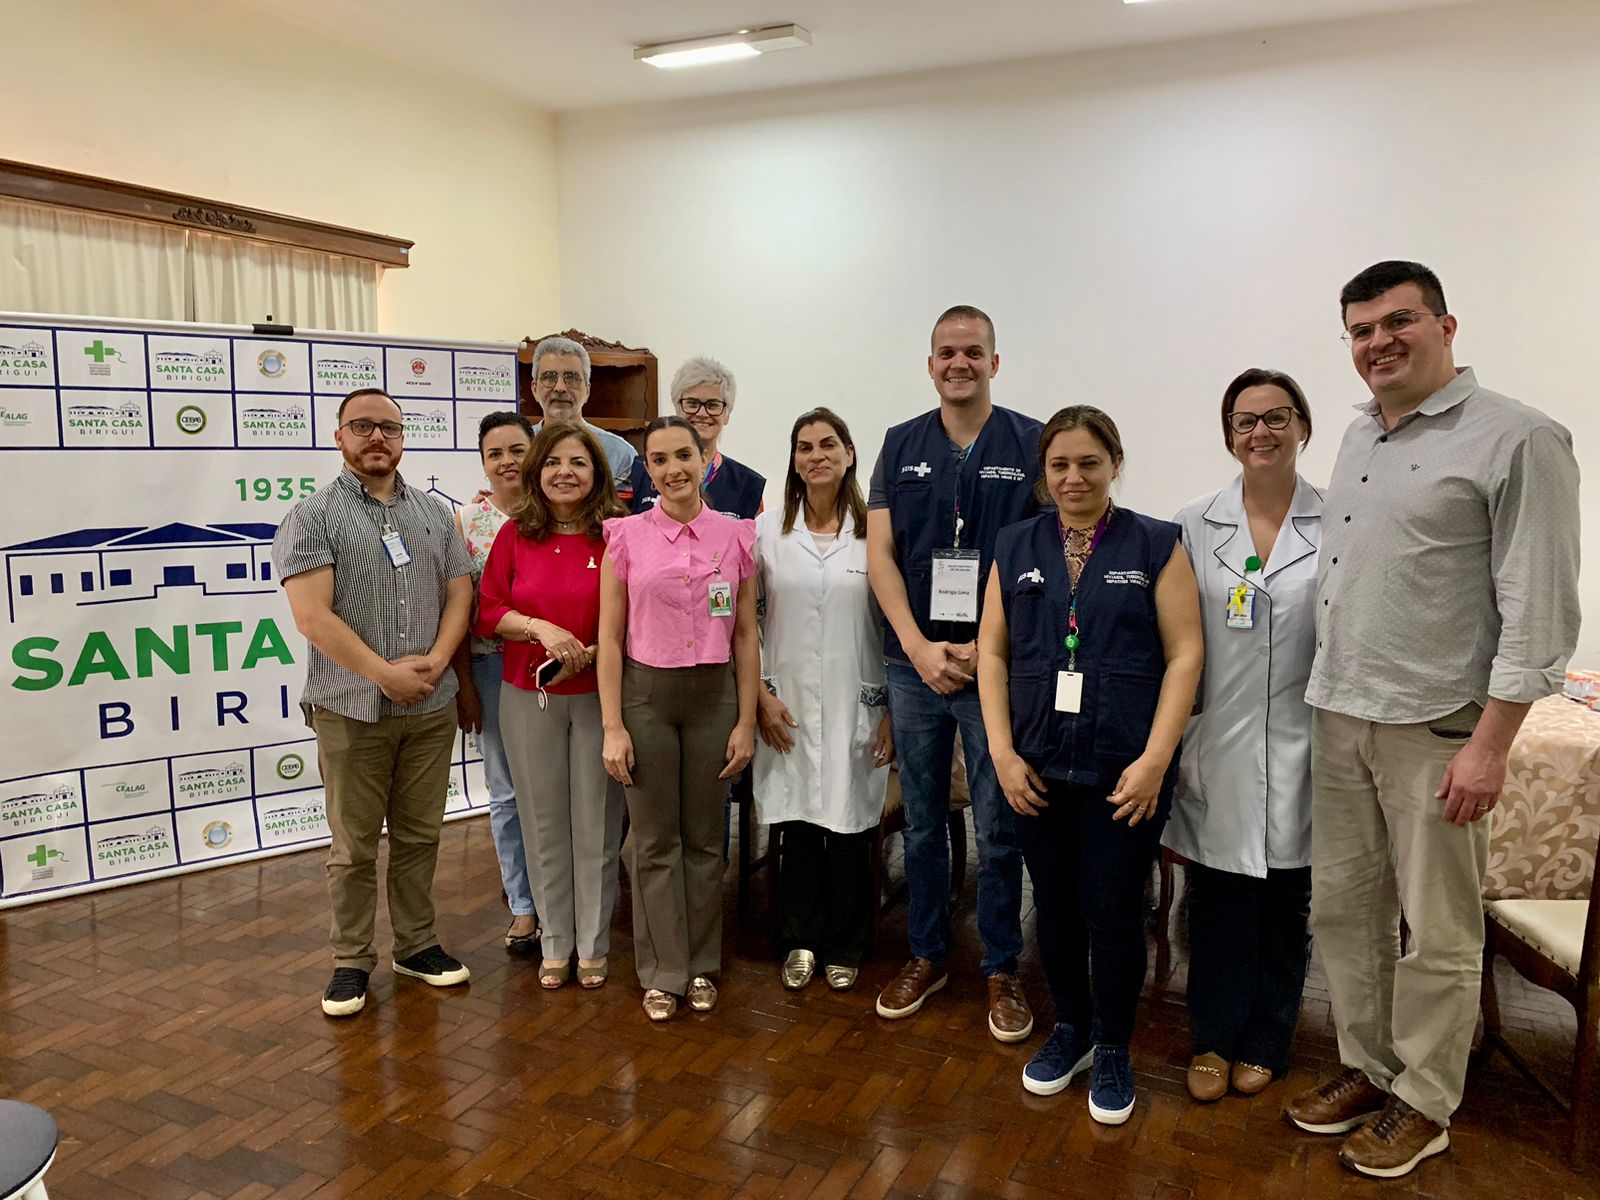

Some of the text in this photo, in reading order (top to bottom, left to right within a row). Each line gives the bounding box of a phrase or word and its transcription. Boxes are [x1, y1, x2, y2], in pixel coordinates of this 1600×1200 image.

[13, 359, 48, 369] CASA
[156, 364, 225, 375] SANTA CASA
[317, 371, 349, 379] SANTA
[458, 377, 512, 387] SANTA CASA
[69, 419, 143, 428] SANTA CASA
[243, 421, 307, 430] SANTA CASA
[235, 477, 317, 502] 1935
[11, 618, 296, 691] SANTA
[180, 776, 246, 793] SANTA CASA
[189, 786, 238, 798] BIRIGUI
[2, 800, 78, 821] SANTA CASA
[13, 812, 70, 826] BIRIGUI
[265, 813, 327, 830] SANTA CASA
[274, 823, 320, 836] BIRIGUI
[98, 841, 169, 860] SANTA CASA
[109, 851, 161, 866] BIRIGUI
